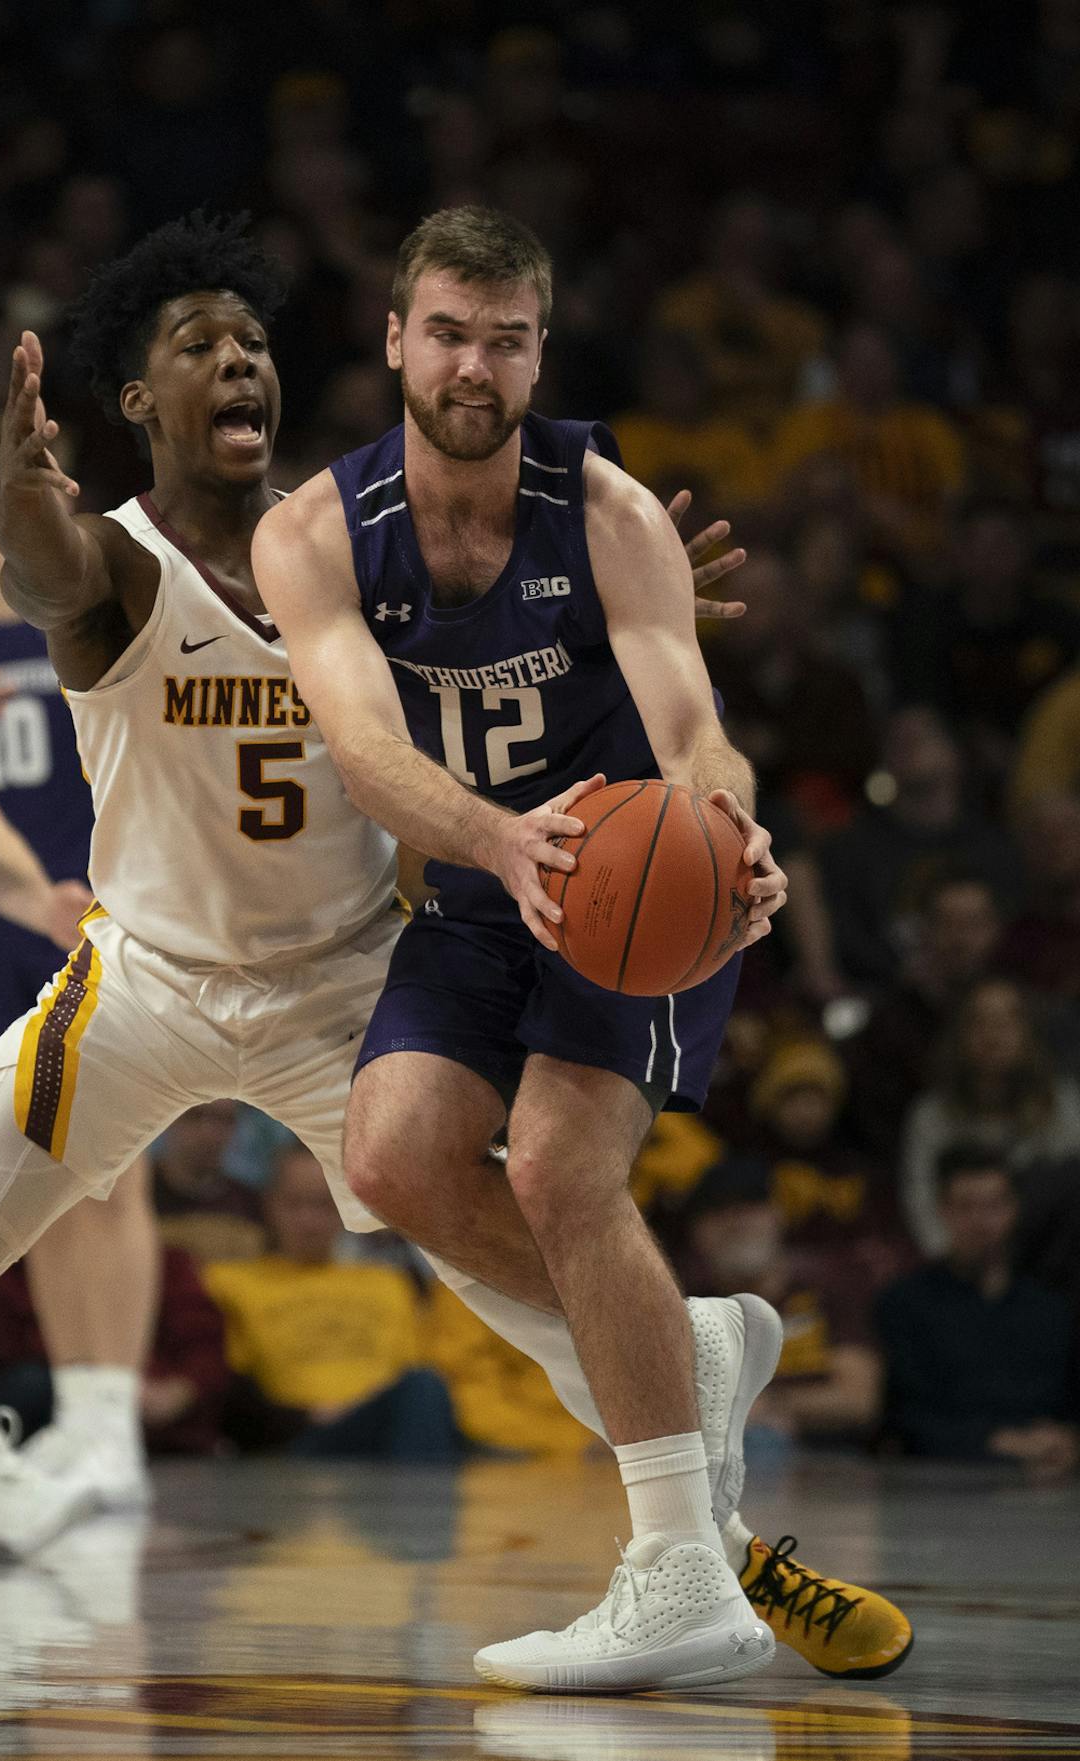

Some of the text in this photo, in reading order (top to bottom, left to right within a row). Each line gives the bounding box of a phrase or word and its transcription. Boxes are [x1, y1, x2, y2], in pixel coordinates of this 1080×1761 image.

[386, 638, 574, 691] THWESTERN
[429, 684, 548, 787] 12
[235, 738, 307, 843] 5
